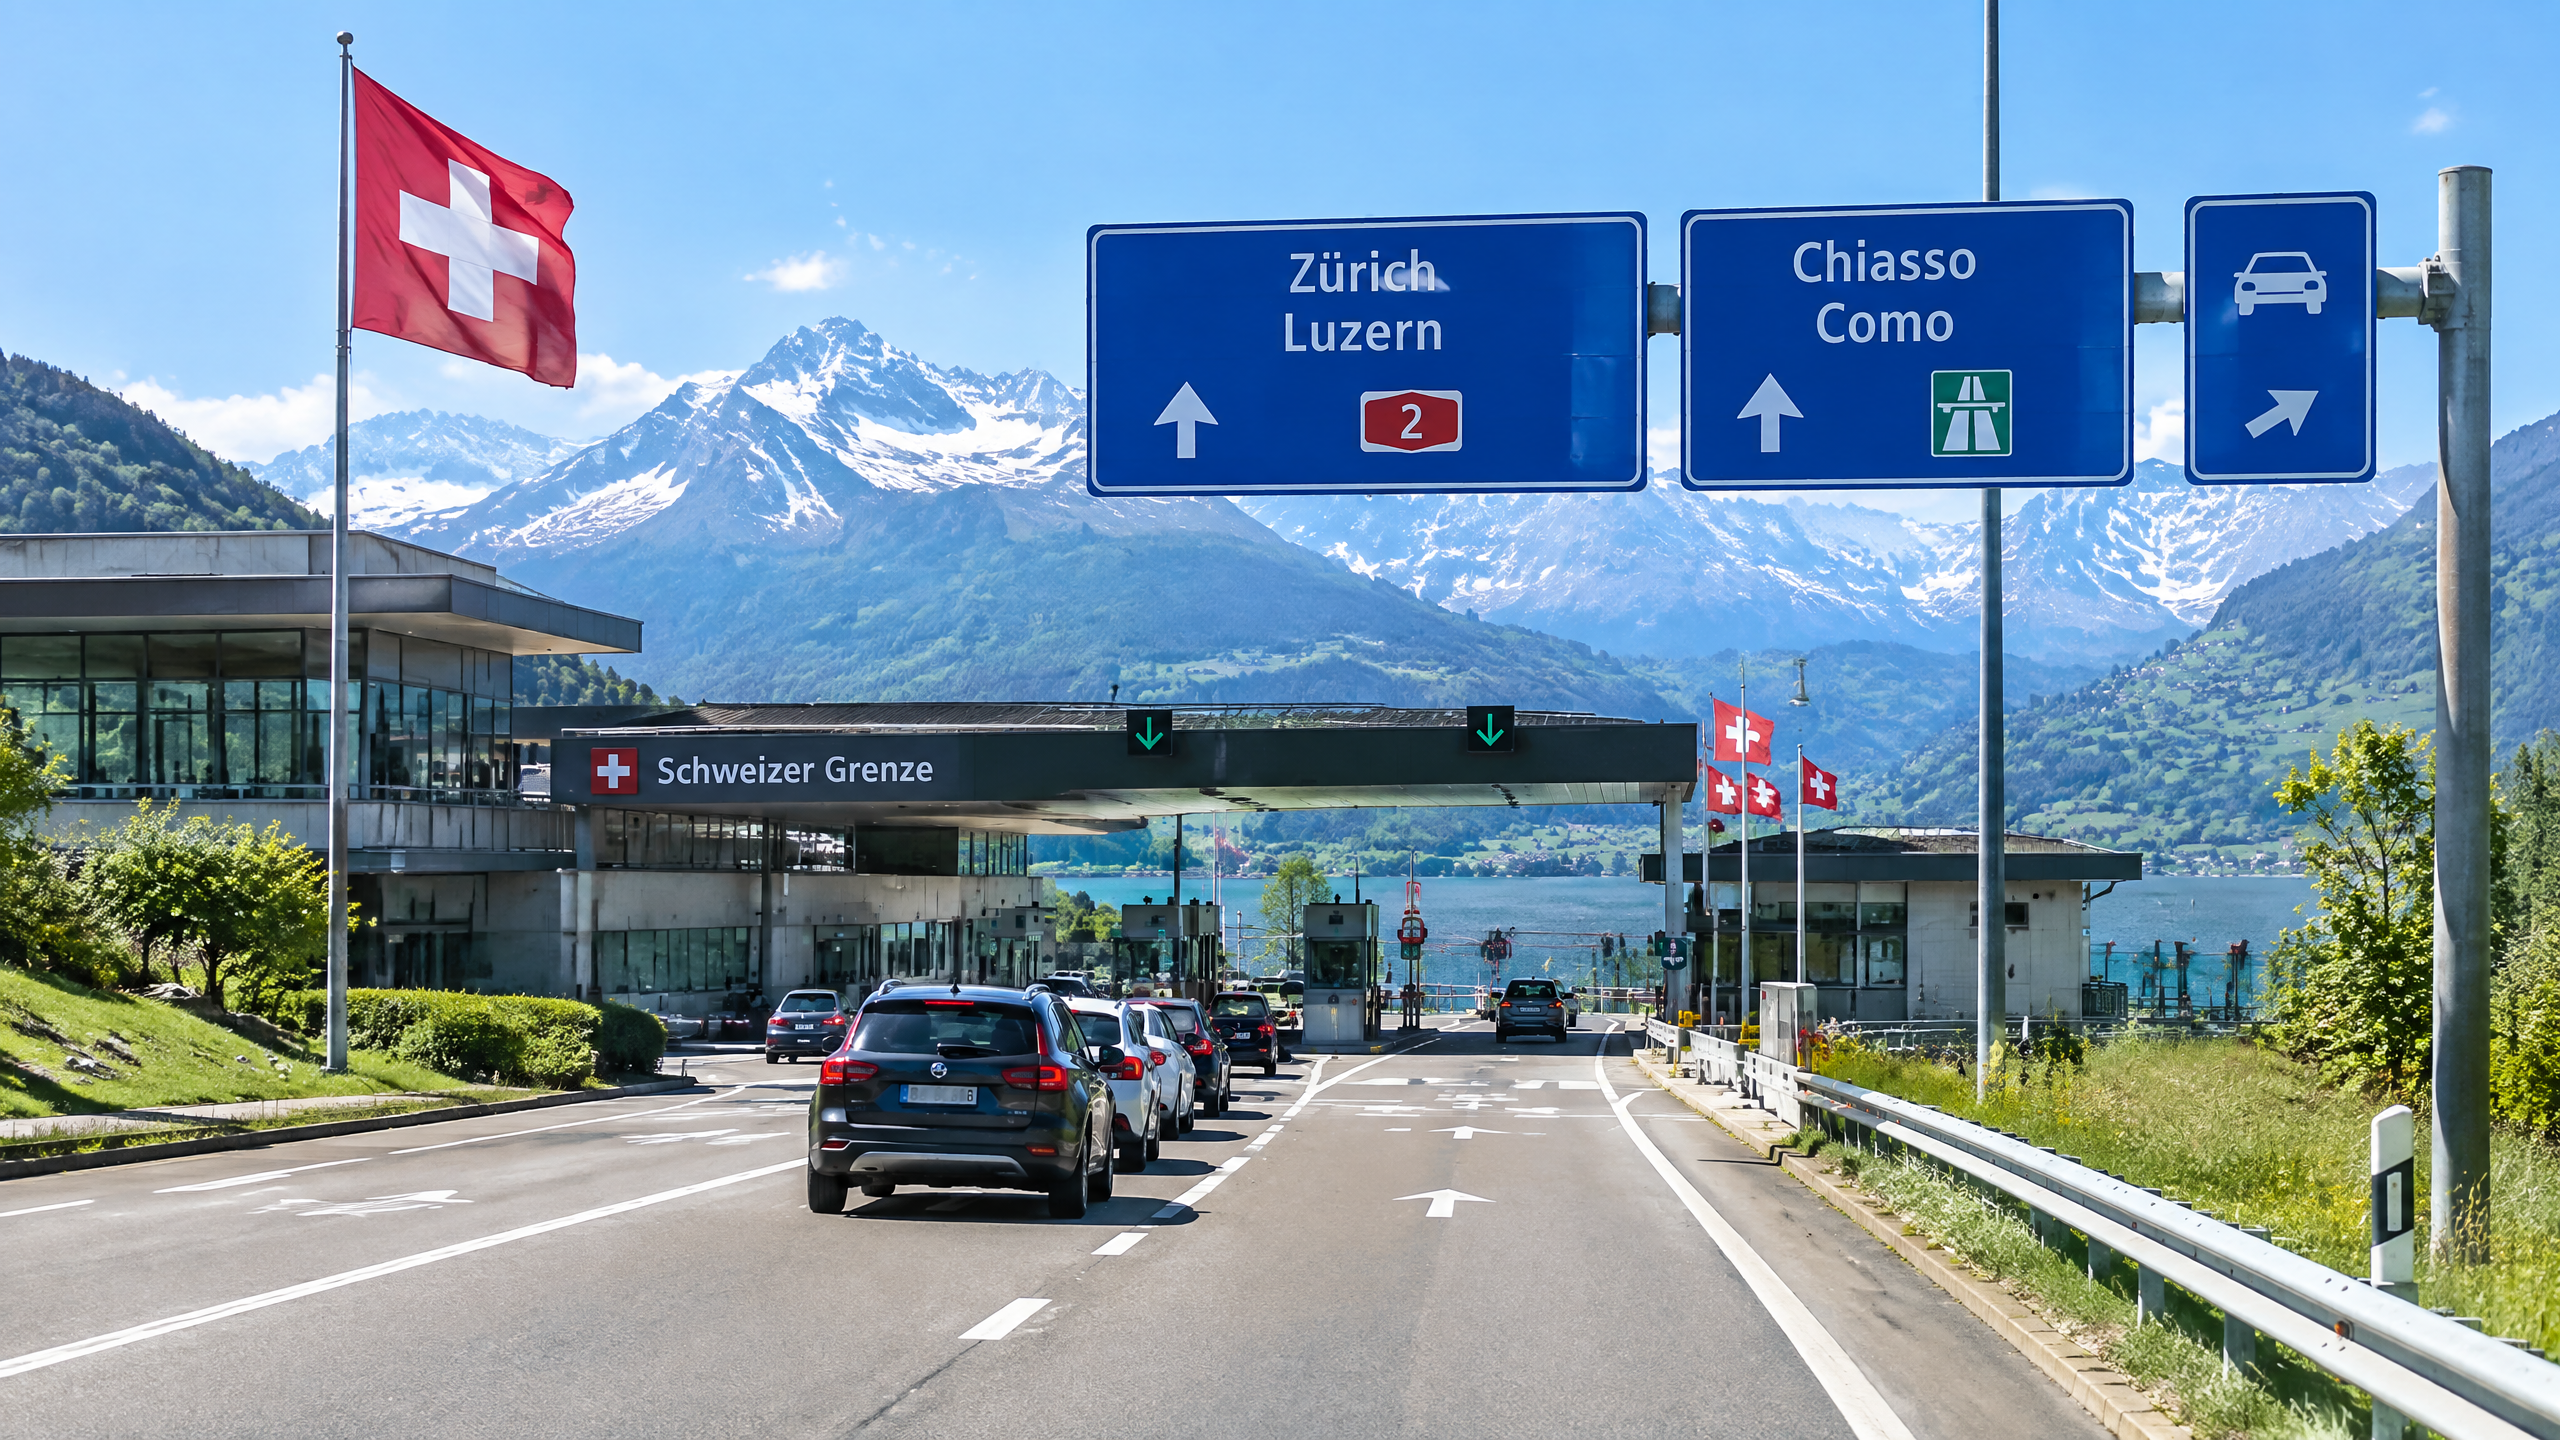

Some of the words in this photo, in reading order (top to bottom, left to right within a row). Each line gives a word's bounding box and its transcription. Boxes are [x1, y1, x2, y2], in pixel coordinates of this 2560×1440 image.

[1289, 248, 1436, 293] Zürich
[1793, 239, 1976, 283] Chiasso
[1285, 312, 1442, 352] Luzern
[1816, 302, 1954, 344] Como
[1400, 403, 1423, 439] 2
[658, 755, 815, 785] Schweizer
[825, 755, 934, 783] Grenze
